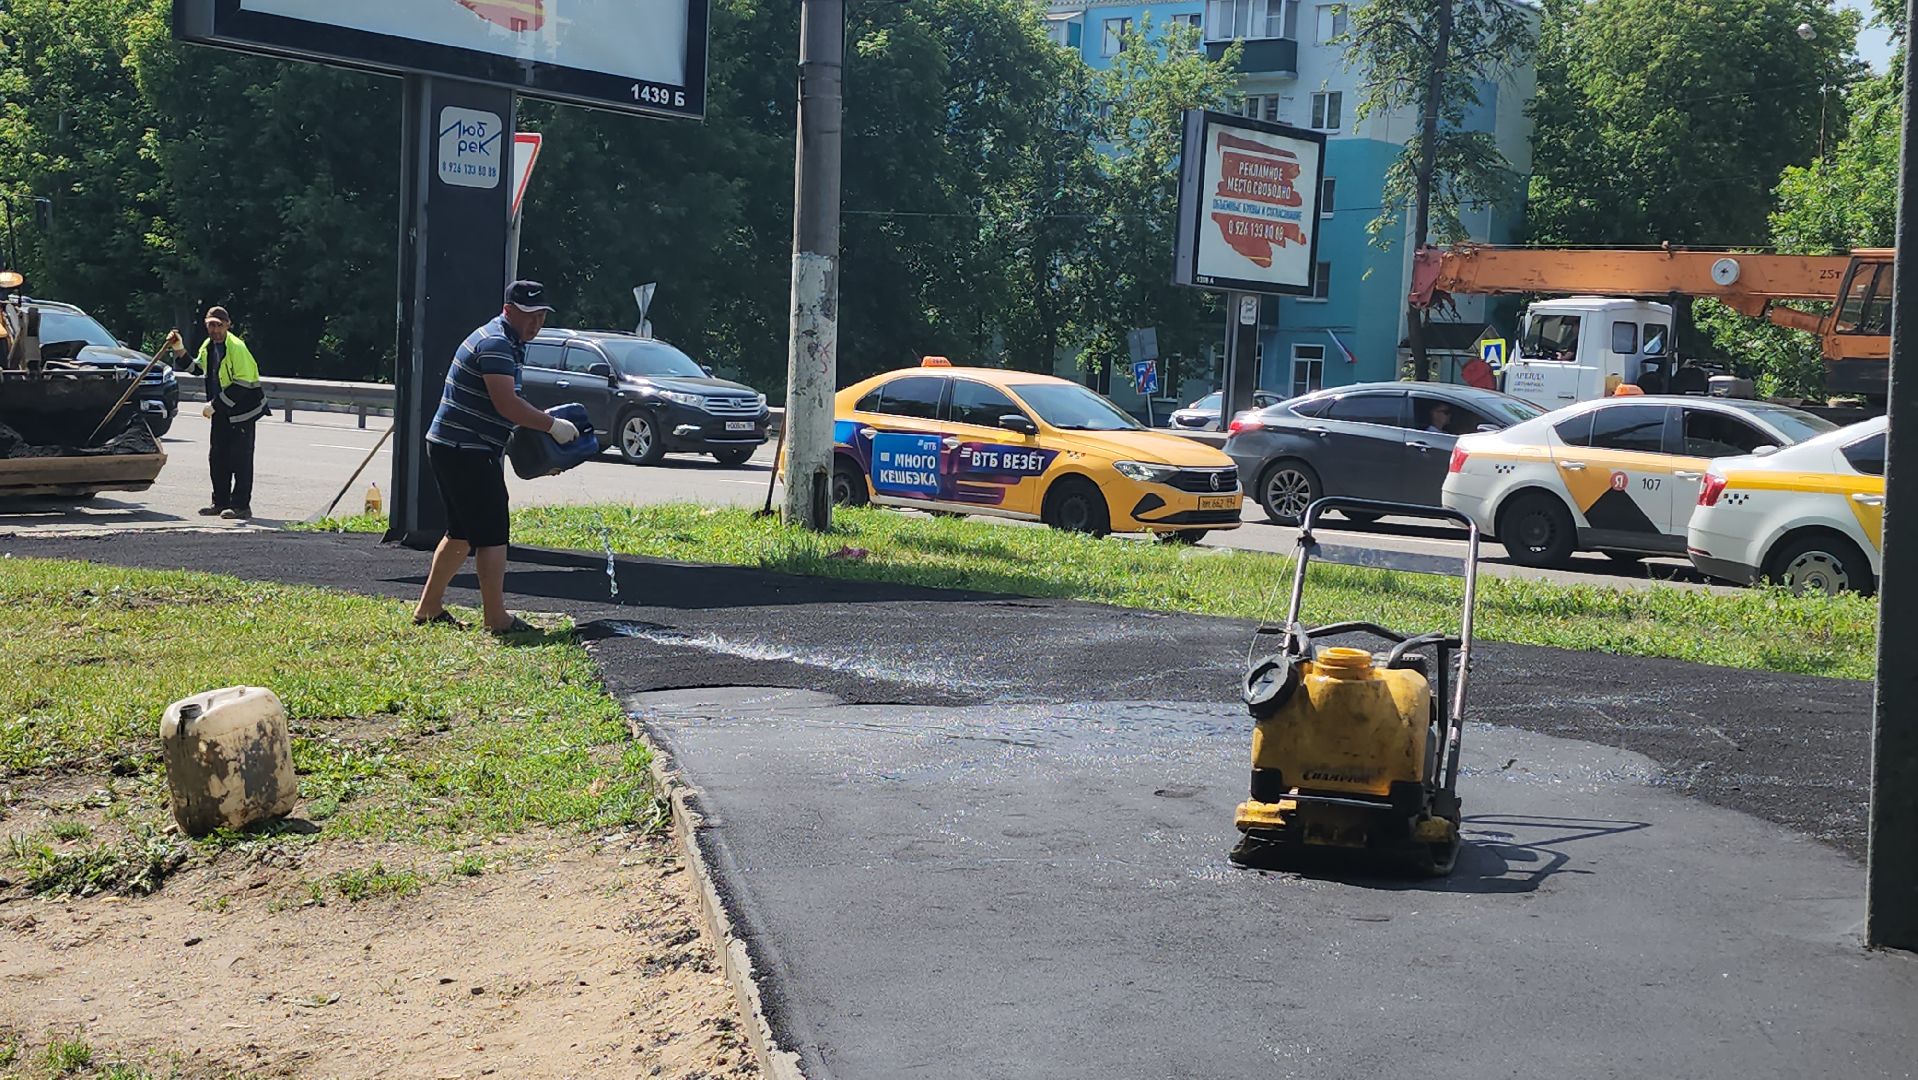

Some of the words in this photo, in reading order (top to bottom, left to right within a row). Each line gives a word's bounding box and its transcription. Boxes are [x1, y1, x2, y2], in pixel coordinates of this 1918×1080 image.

[631, 84, 670, 105] 1439
[674, 91, 685, 107] Б
[440, 120, 487, 138] Люб
[448, 162, 461, 174] 926
[464, 164, 477, 175] 133
[1239, 162, 1284, 181] РЕКЛАМНОЕ
[1227, 176, 1252, 194] МЕСТО
[1252, 181, 1291, 200] СВОБОДНО
[1235, 221, 1248, 236] 926
[1250, 223, 1264, 238] 133
[923, 441, 937, 451] ВТБ
[894, 453, 936, 470] МНОГО
[971, 451, 999, 468] ВТБ
[880, 469, 938, 487] КЕШБЭКА
[1615, 474, 1624, 488] Я
[1641, 477, 1662, 491] 107
